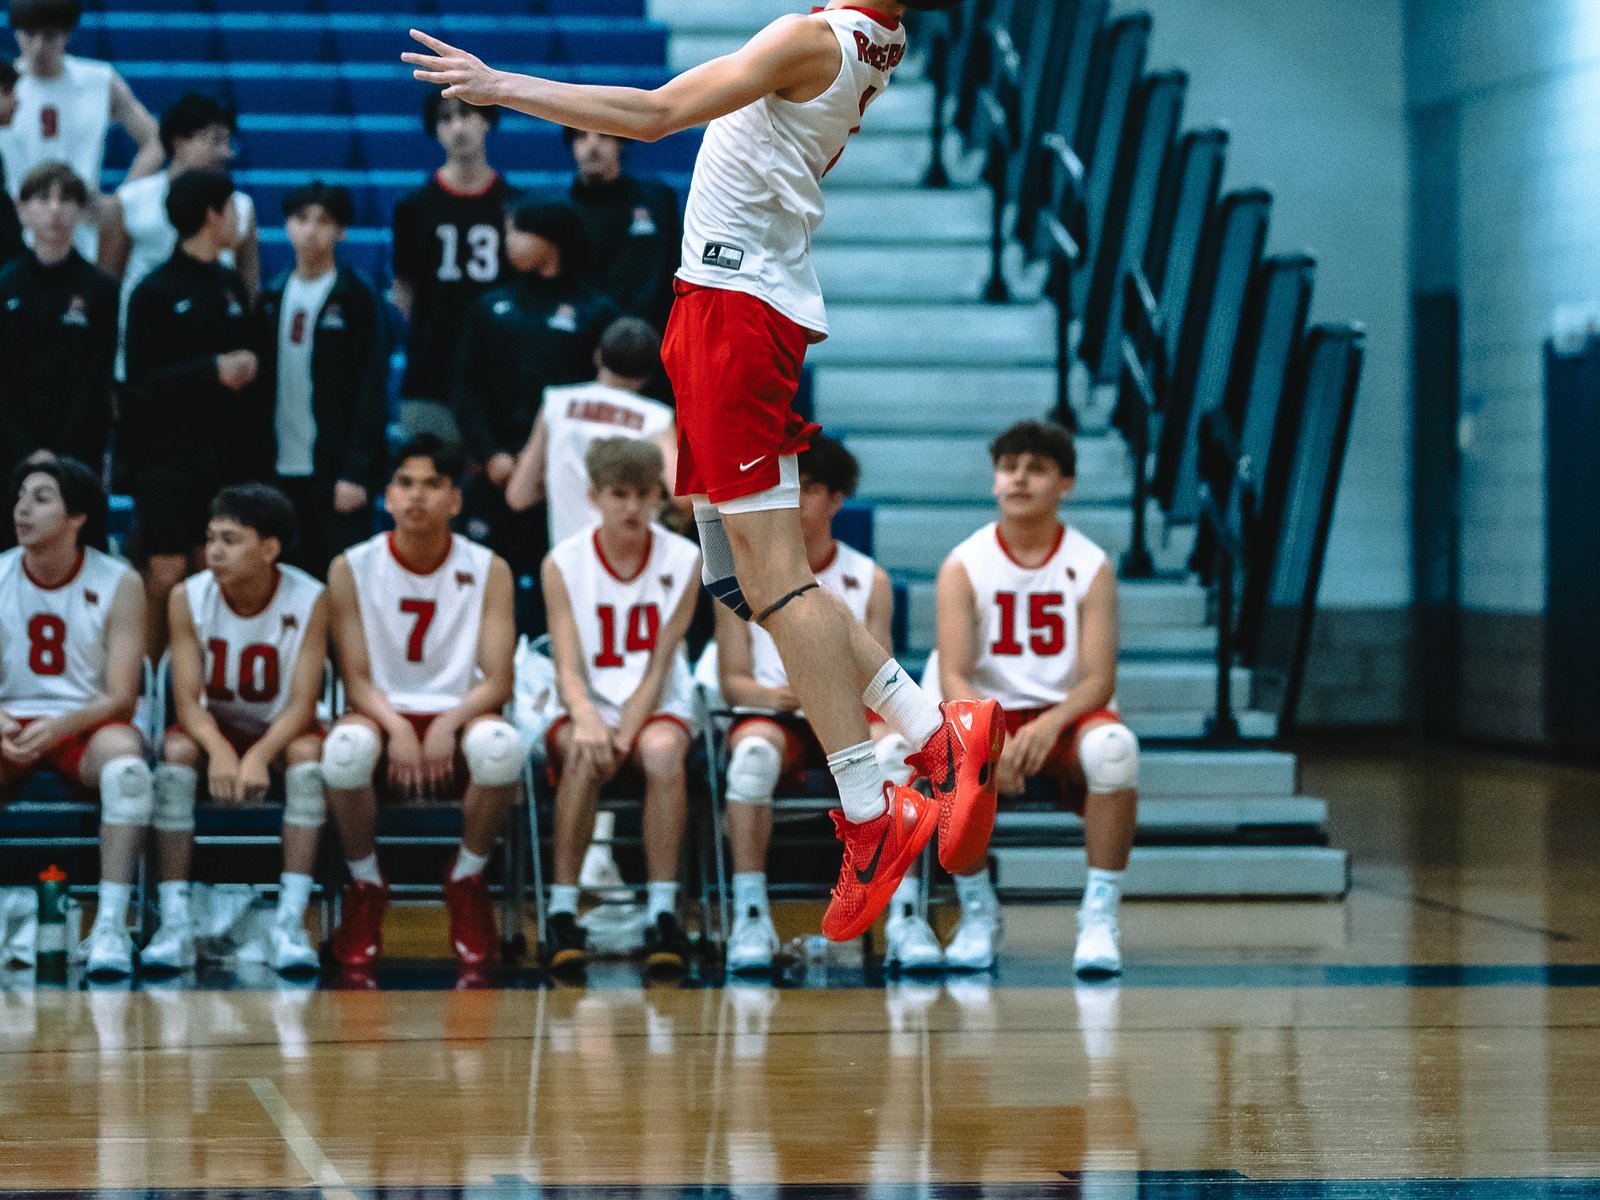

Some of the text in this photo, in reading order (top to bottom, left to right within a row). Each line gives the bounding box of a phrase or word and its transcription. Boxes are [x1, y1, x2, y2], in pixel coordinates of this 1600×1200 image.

[436, 223, 499, 281] 13
[28, 613, 66, 676] 8
[400, 598, 437, 662] 7
[594, 603, 660, 668] 14
[991, 591, 1065, 656] 15
[206, 637, 280, 703] 10
